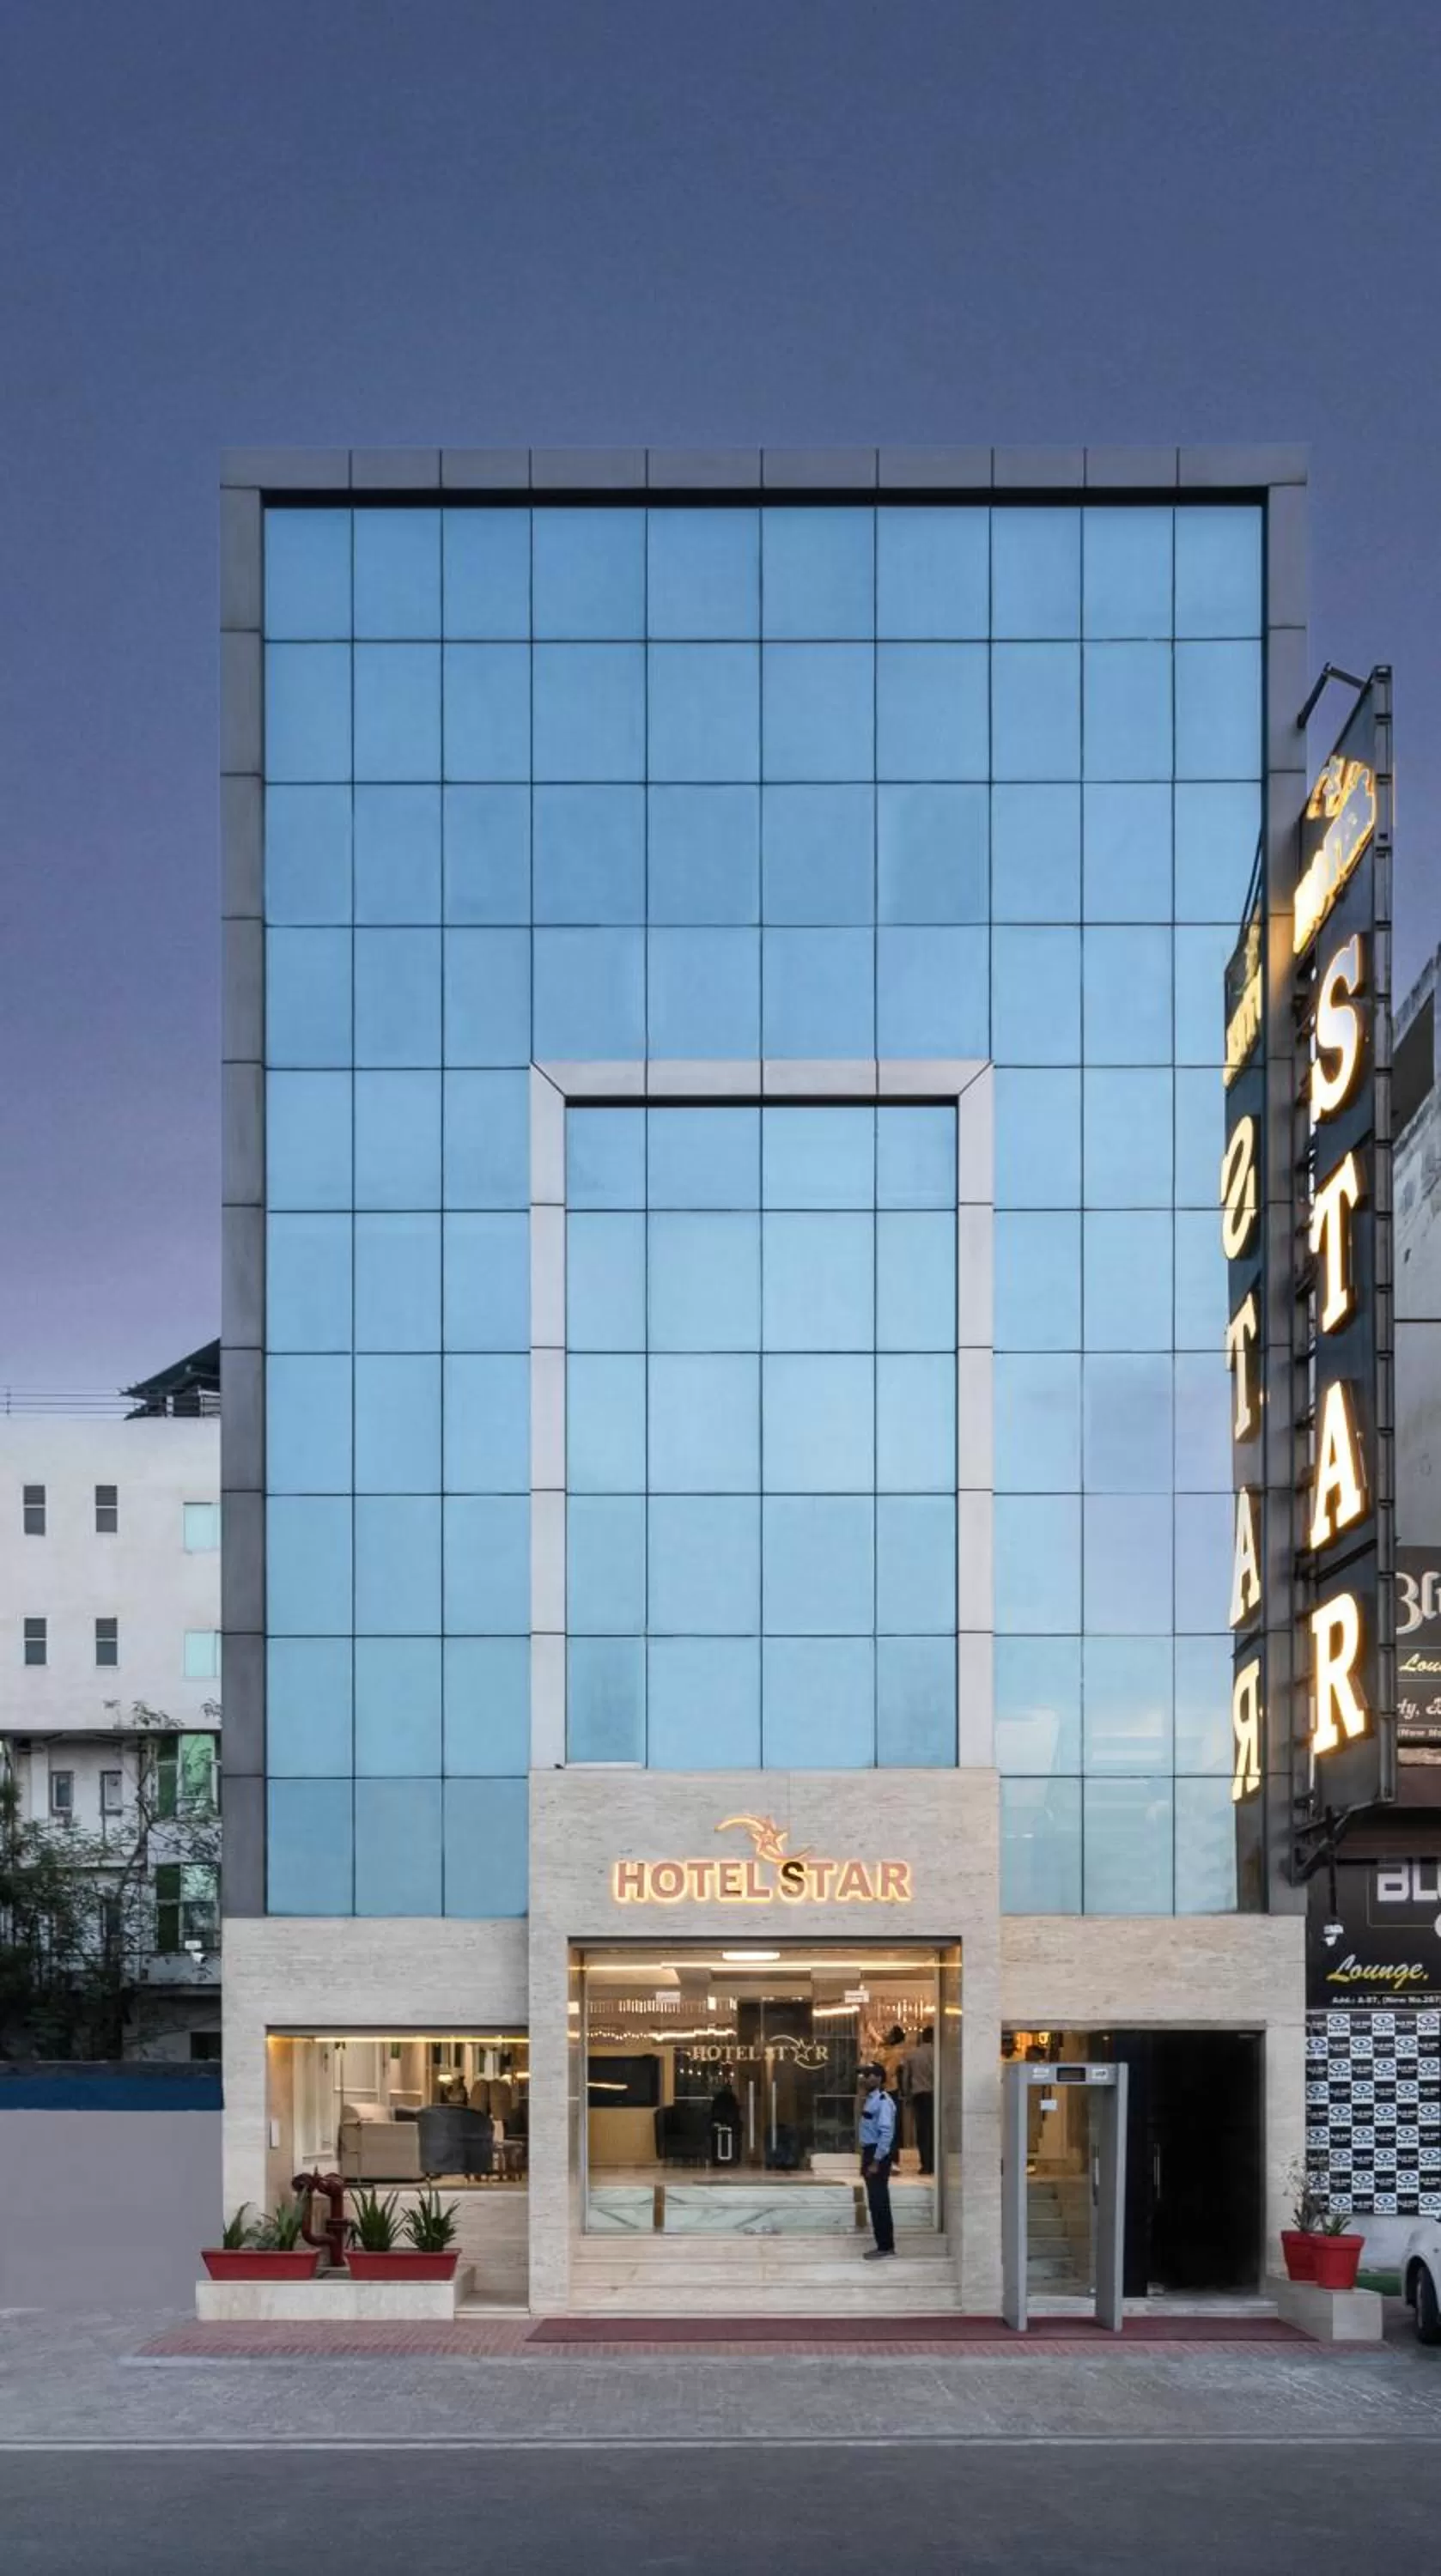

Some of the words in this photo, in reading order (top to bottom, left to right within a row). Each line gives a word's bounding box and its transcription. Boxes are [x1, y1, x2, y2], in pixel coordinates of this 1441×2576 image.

[1310, 933, 1368, 1757] STAR
[615, 1861, 772, 1900] HOTEL
[780, 1861, 911, 1900] STAR
[1326, 1954, 1430, 1990] Lounge.
[692, 2045, 762, 2062] HOTEL
